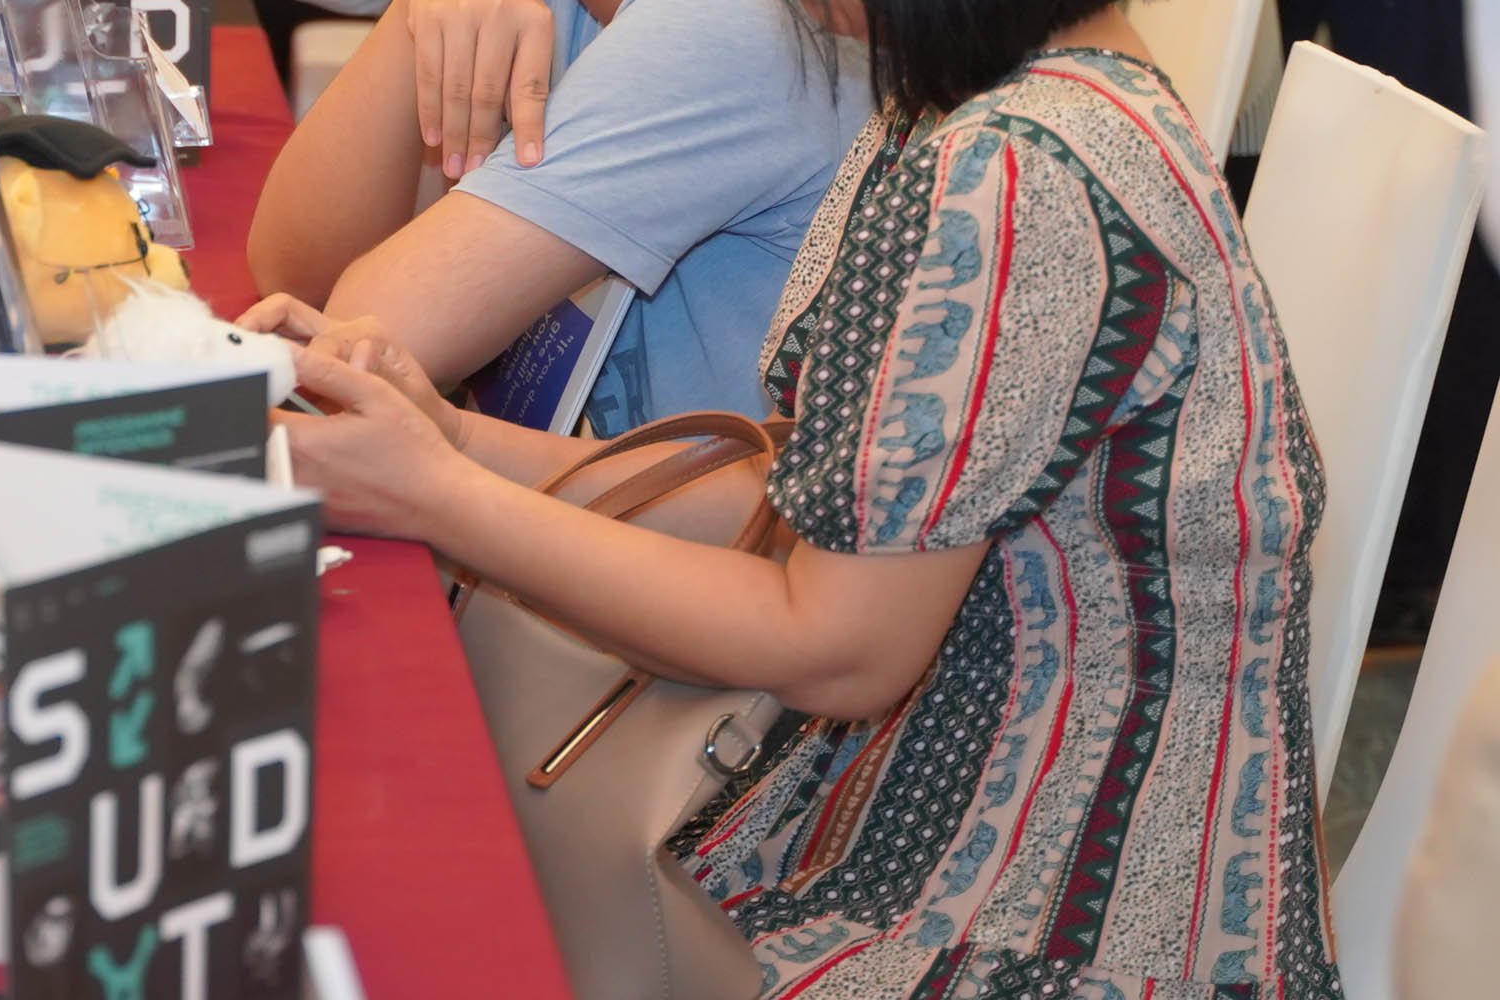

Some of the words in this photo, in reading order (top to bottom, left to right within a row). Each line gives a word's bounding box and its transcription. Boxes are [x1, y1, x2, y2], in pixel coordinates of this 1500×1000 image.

[536, 353, 555, 385] you
[538, 320, 561, 358] give
[9, 649, 90, 801] S
[88, 773, 165, 921] U
[229, 727, 311, 869] D
[158, 891, 234, 1000] T
